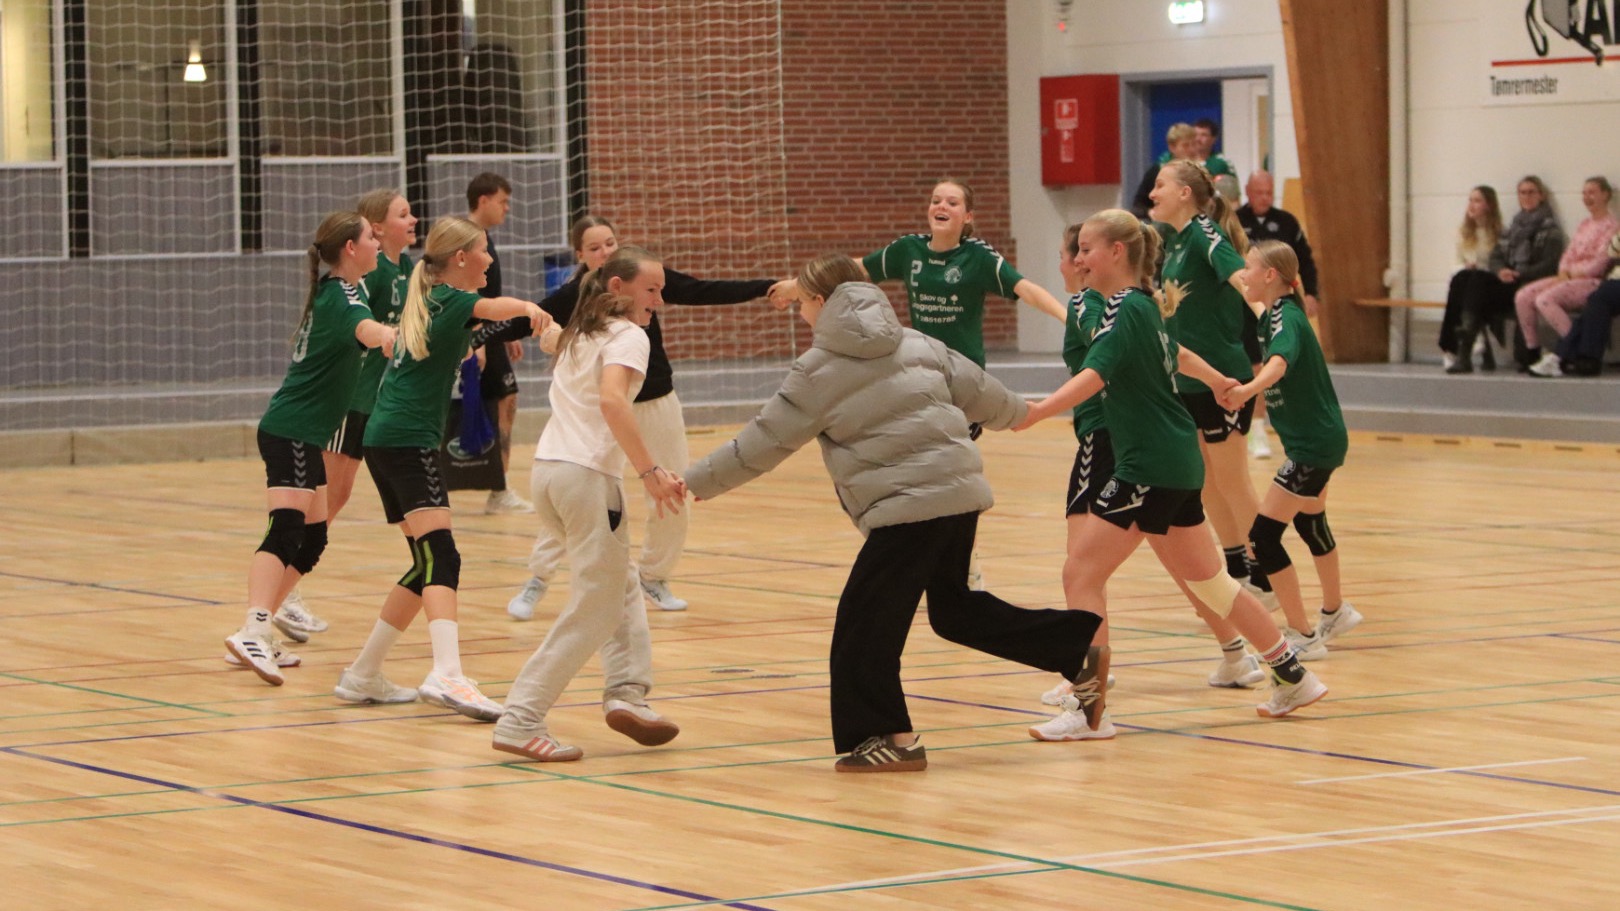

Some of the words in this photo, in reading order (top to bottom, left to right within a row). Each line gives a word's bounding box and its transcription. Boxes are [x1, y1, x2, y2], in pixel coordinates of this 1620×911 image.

[910, 260, 923, 287] 2
[919, 293, 937, 302] Skov
[937, 296, 947, 304] og
